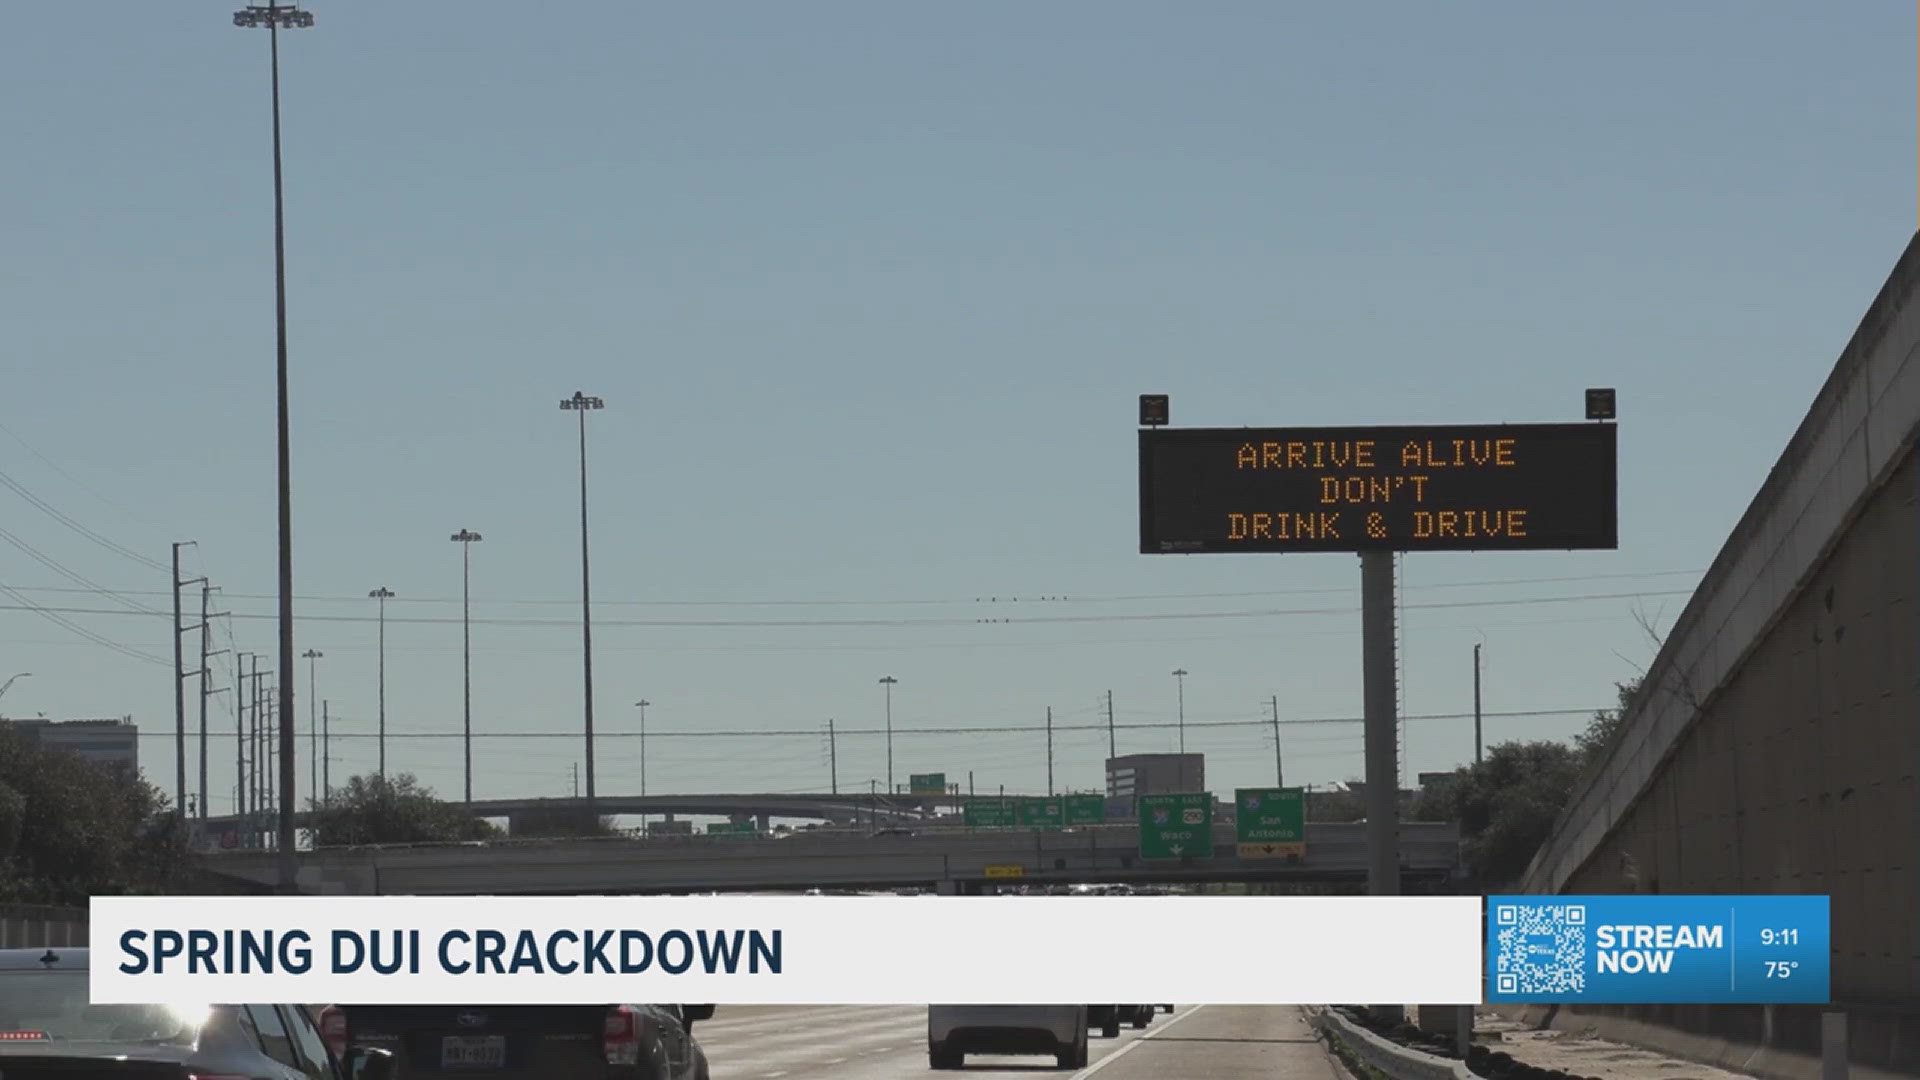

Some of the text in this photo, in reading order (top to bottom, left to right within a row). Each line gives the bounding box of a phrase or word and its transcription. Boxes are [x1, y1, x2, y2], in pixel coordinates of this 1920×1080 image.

[1237, 438, 1515, 469] ARRIVE ALIVE
[1321, 475, 1430, 505] DON'T
[1229, 510, 1526, 541] DRINK & DRIVE
[1259, 816, 1281, 825] San
[1160, 831, 1193, 841] Waco
[1248, 829, 1295, 839] Antonio
